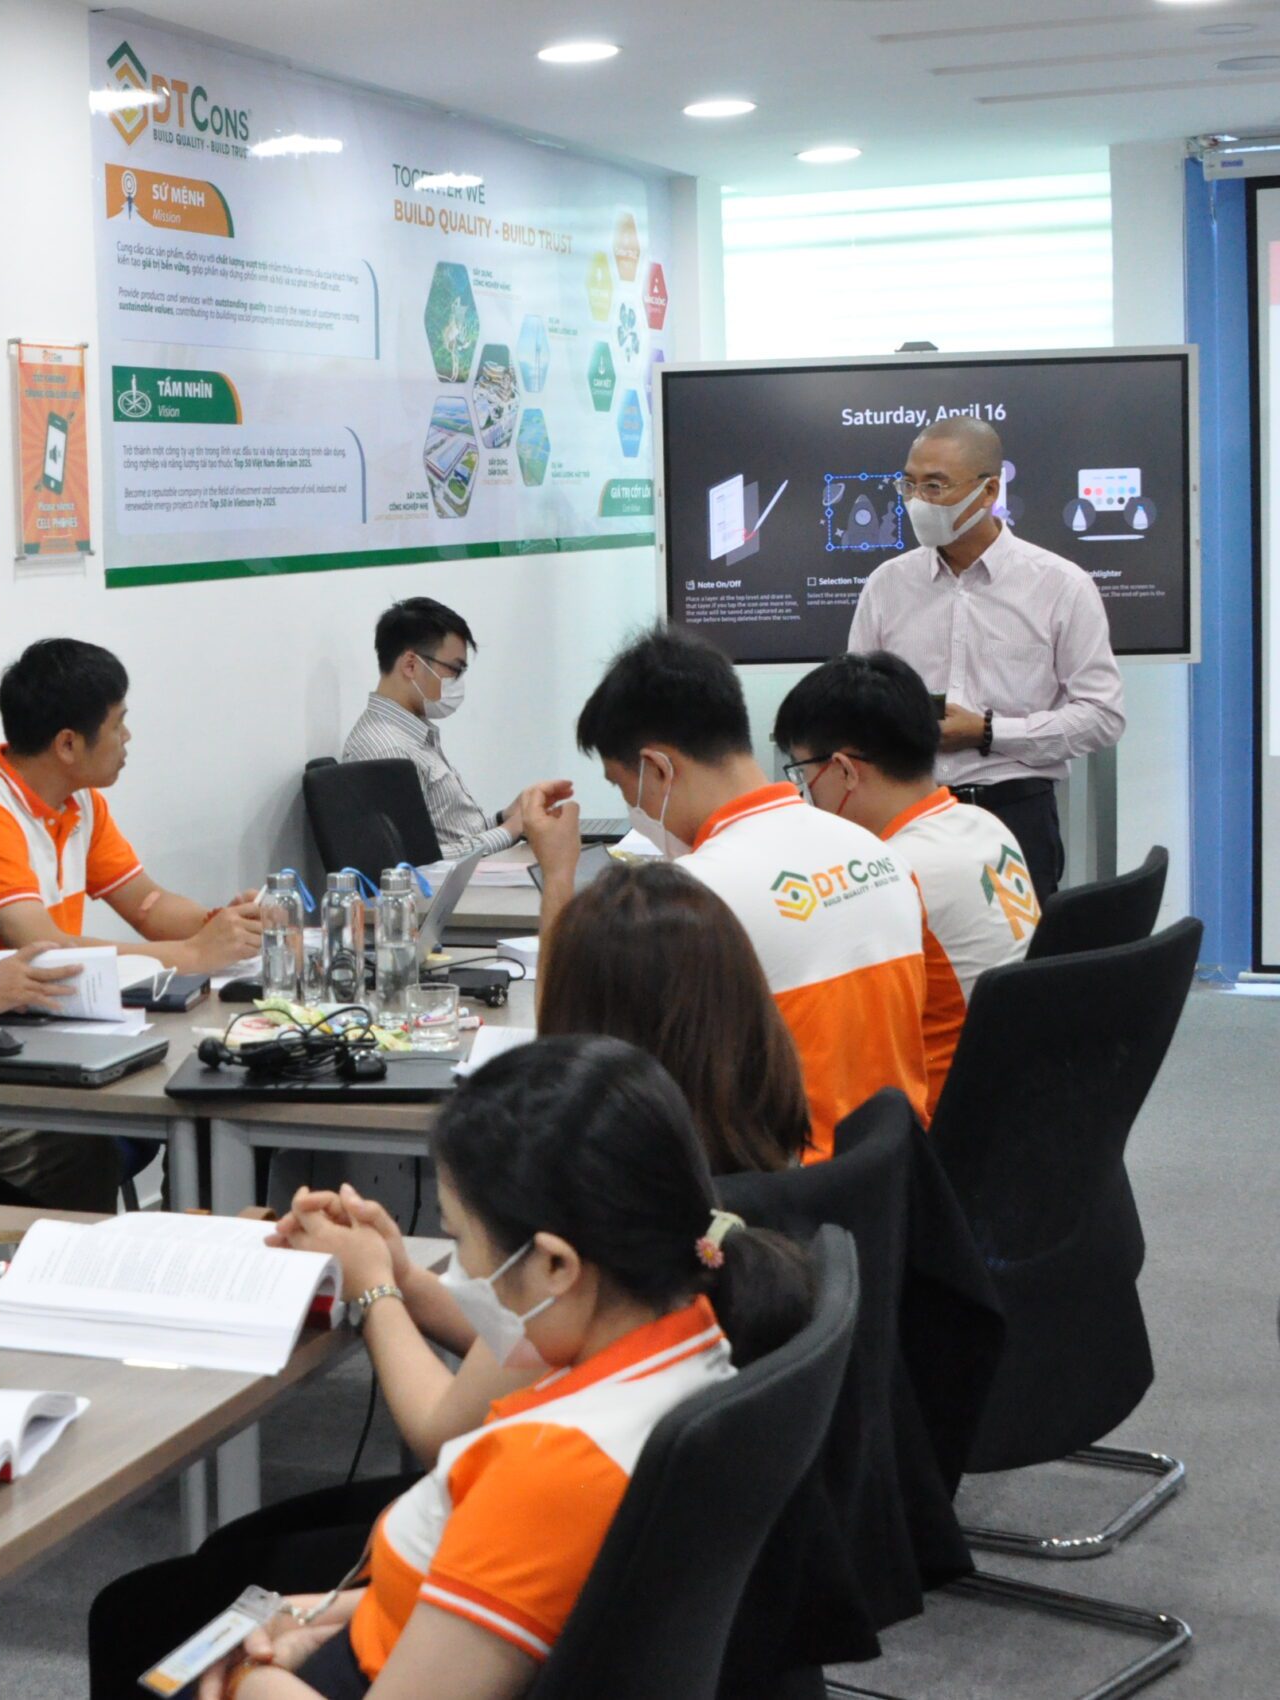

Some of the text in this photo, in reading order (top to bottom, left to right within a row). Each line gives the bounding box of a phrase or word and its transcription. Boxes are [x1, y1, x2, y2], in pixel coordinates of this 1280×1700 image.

[153, 128, 173, 144] BUILD
[176, 133, 205, 150] QUALITY
[211, 140, 229, 155] BUILD
[231, 145, 250, 159] TRUS
[152, 208, 181, 224] Mission
[394, 199, 435, 227] BUILD
[439, 208, 492, 238] QUALITY
[502, 222, 535, 246] BUILD
[538, 229, 573, 254] TRUST
[158, 405, 180, 417] Vision
[841, 405, 931, 428] Saturday,
[985, 403, 1007, 421] 16
[698, 580, 742, 589] Note On/Off
[819, 577, 852, 585] Selection
